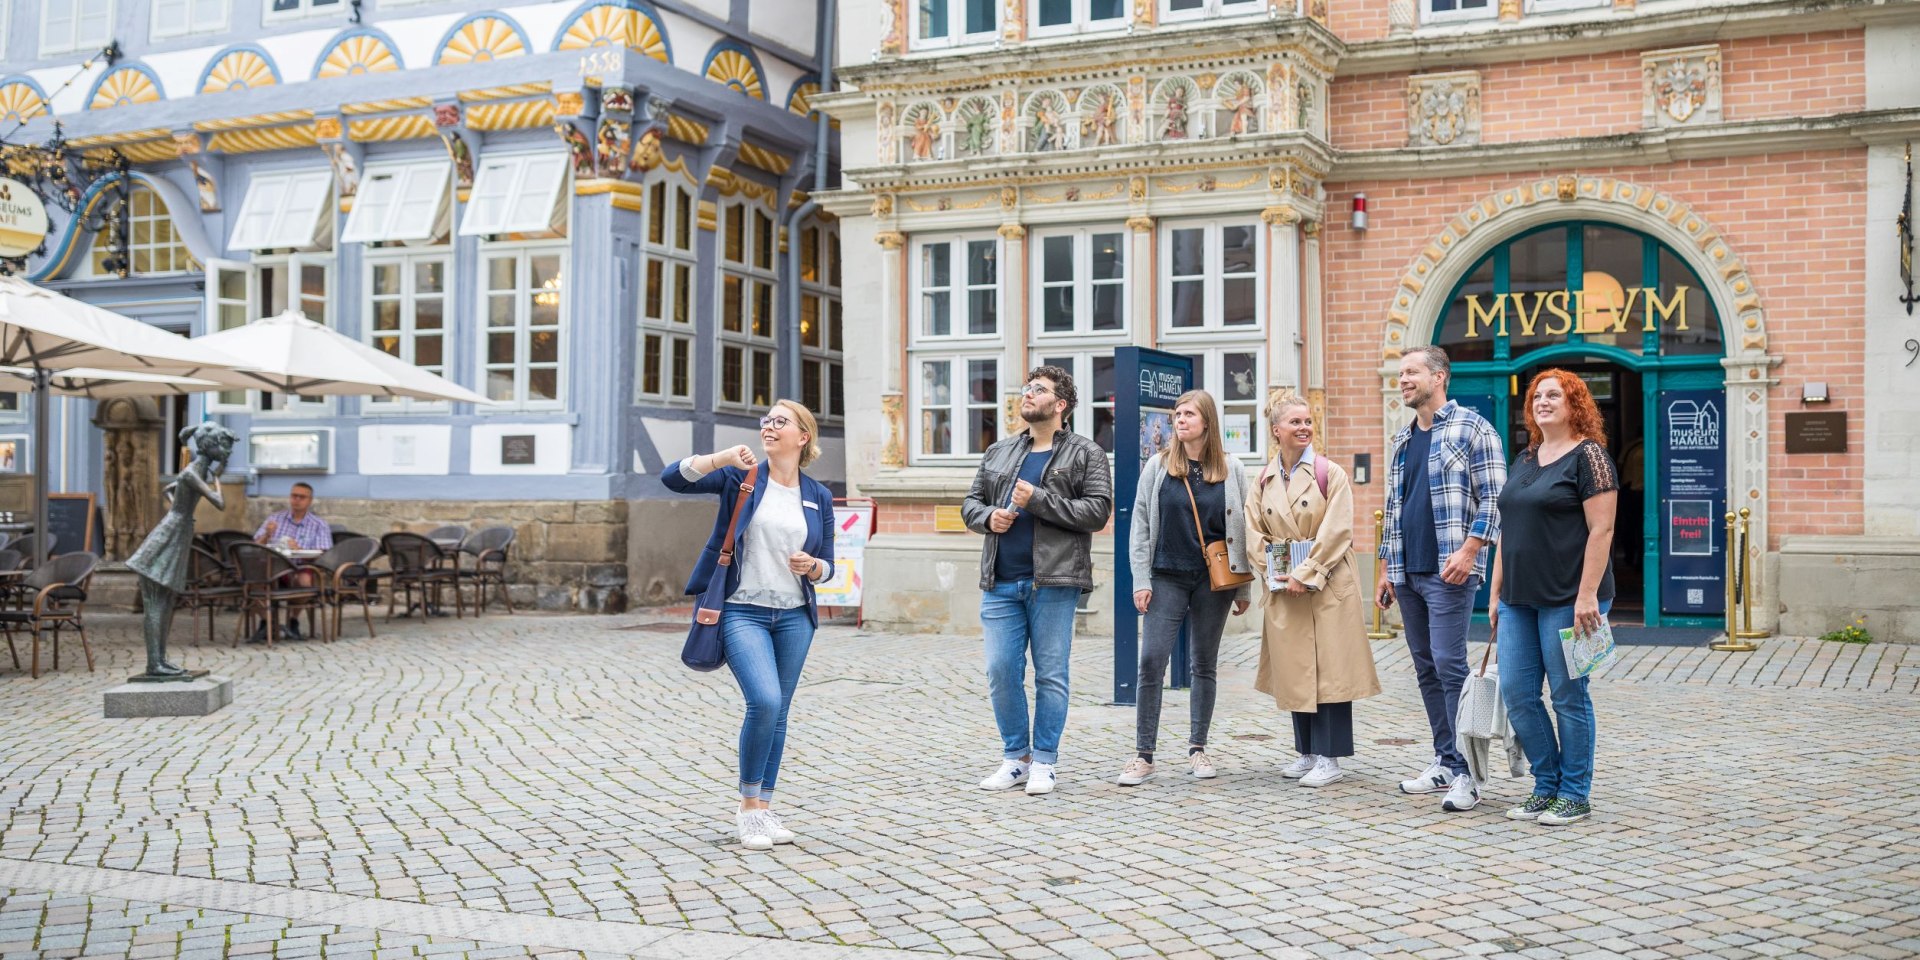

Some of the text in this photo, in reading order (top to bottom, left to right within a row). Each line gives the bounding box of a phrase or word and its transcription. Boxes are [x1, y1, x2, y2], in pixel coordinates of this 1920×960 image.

[1465, 286, 1690, 337] MVSEVM
[1158, 372, 1182, 384] museum
[1158, 381, 1182, 395] HAMELN
[1670, 429, 1719, 437] museum
[1670, 436, 1719, 446] HAMELN
[1673, 516, 1709, 527] Eintritt
